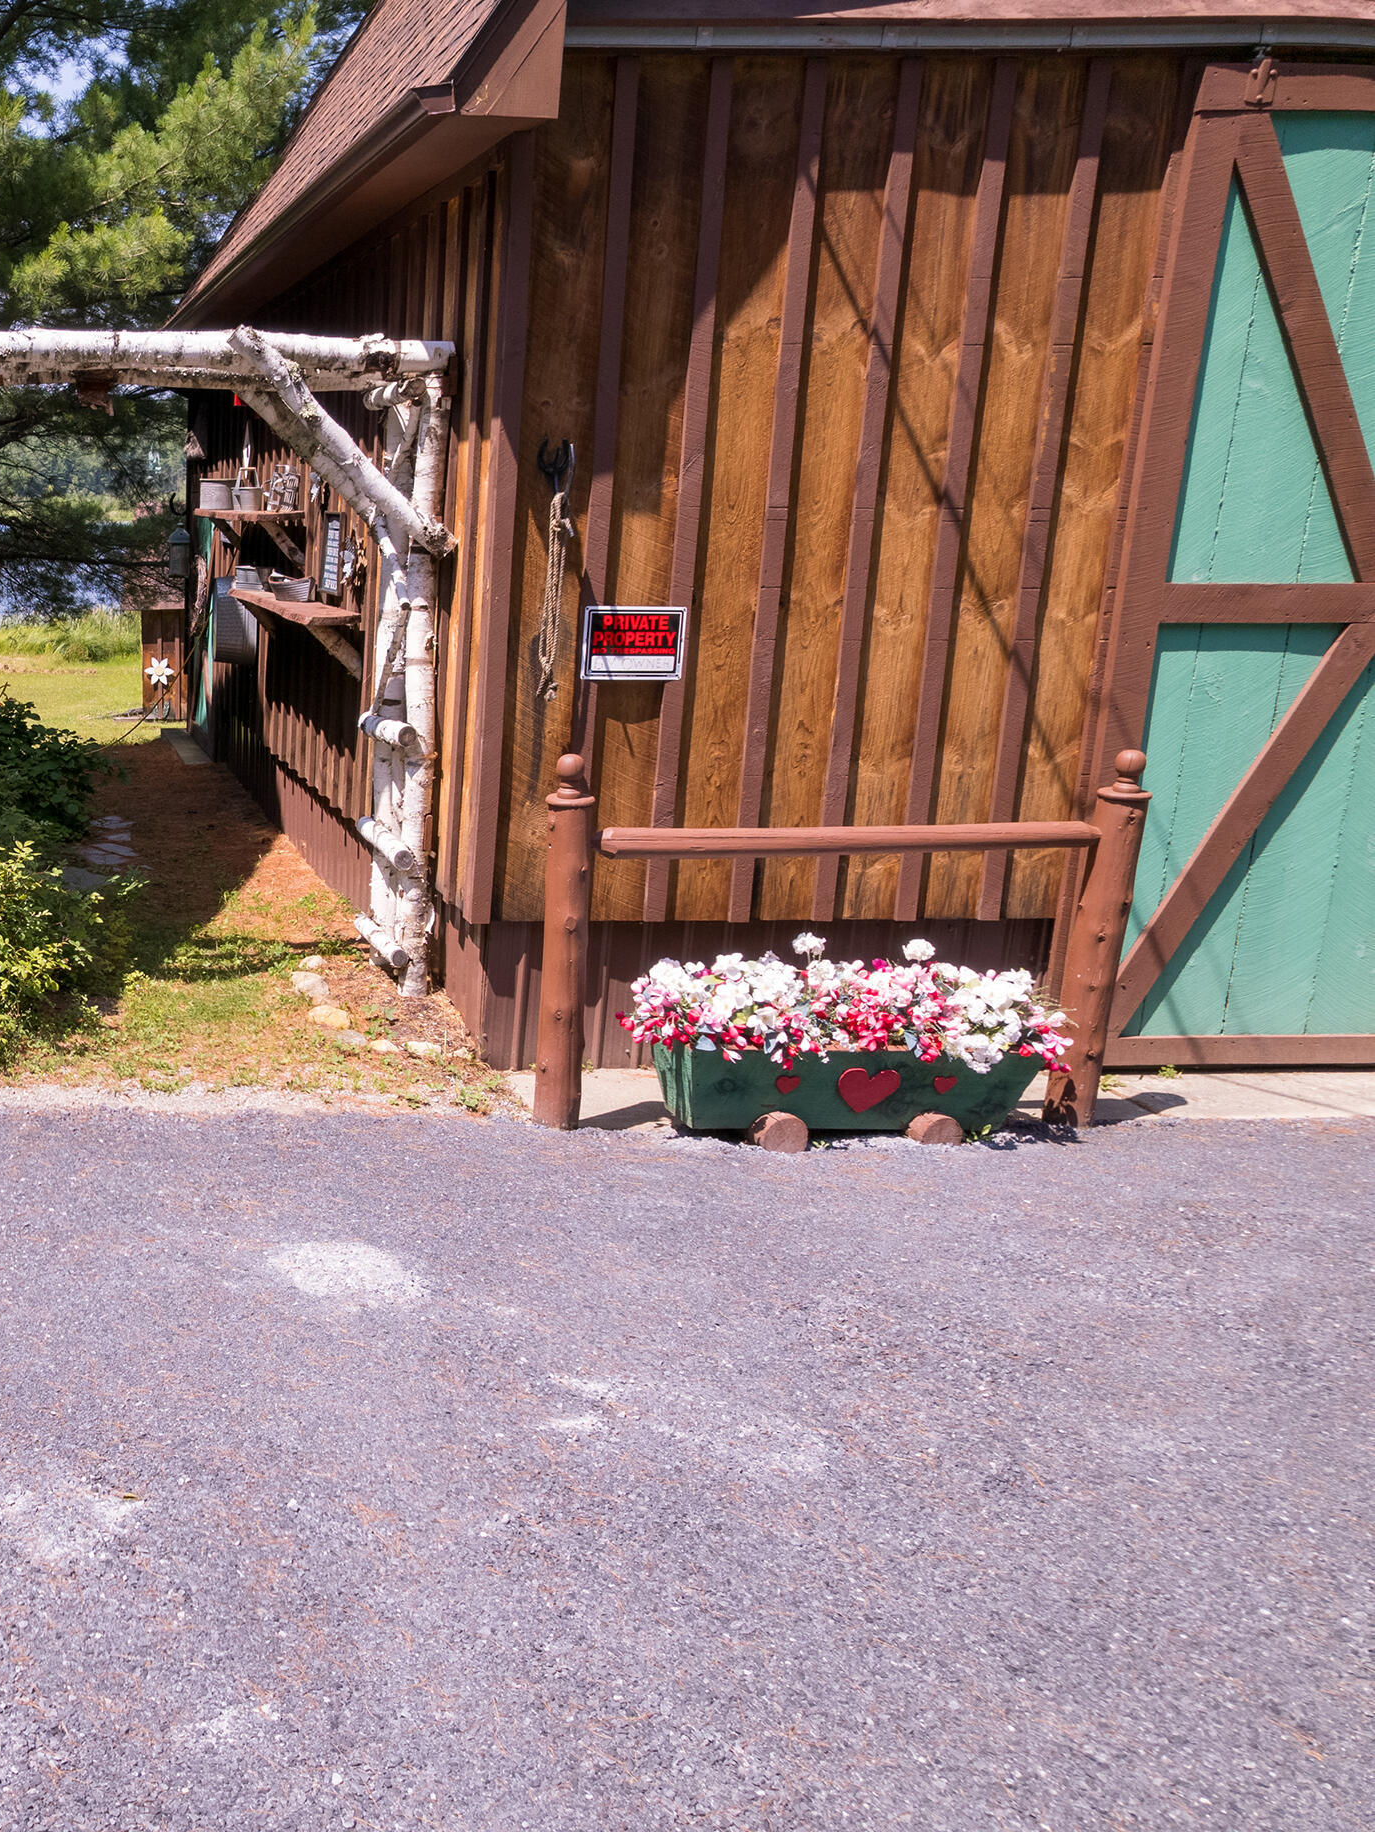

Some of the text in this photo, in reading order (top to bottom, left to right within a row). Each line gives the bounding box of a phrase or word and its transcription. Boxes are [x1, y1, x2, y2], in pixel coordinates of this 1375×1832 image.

[602, 614, 670, 631] PRIVATE
[592, 631, 677, 647] PROPERTY
[592, 647, 676, 655] NO TRESPASSING
